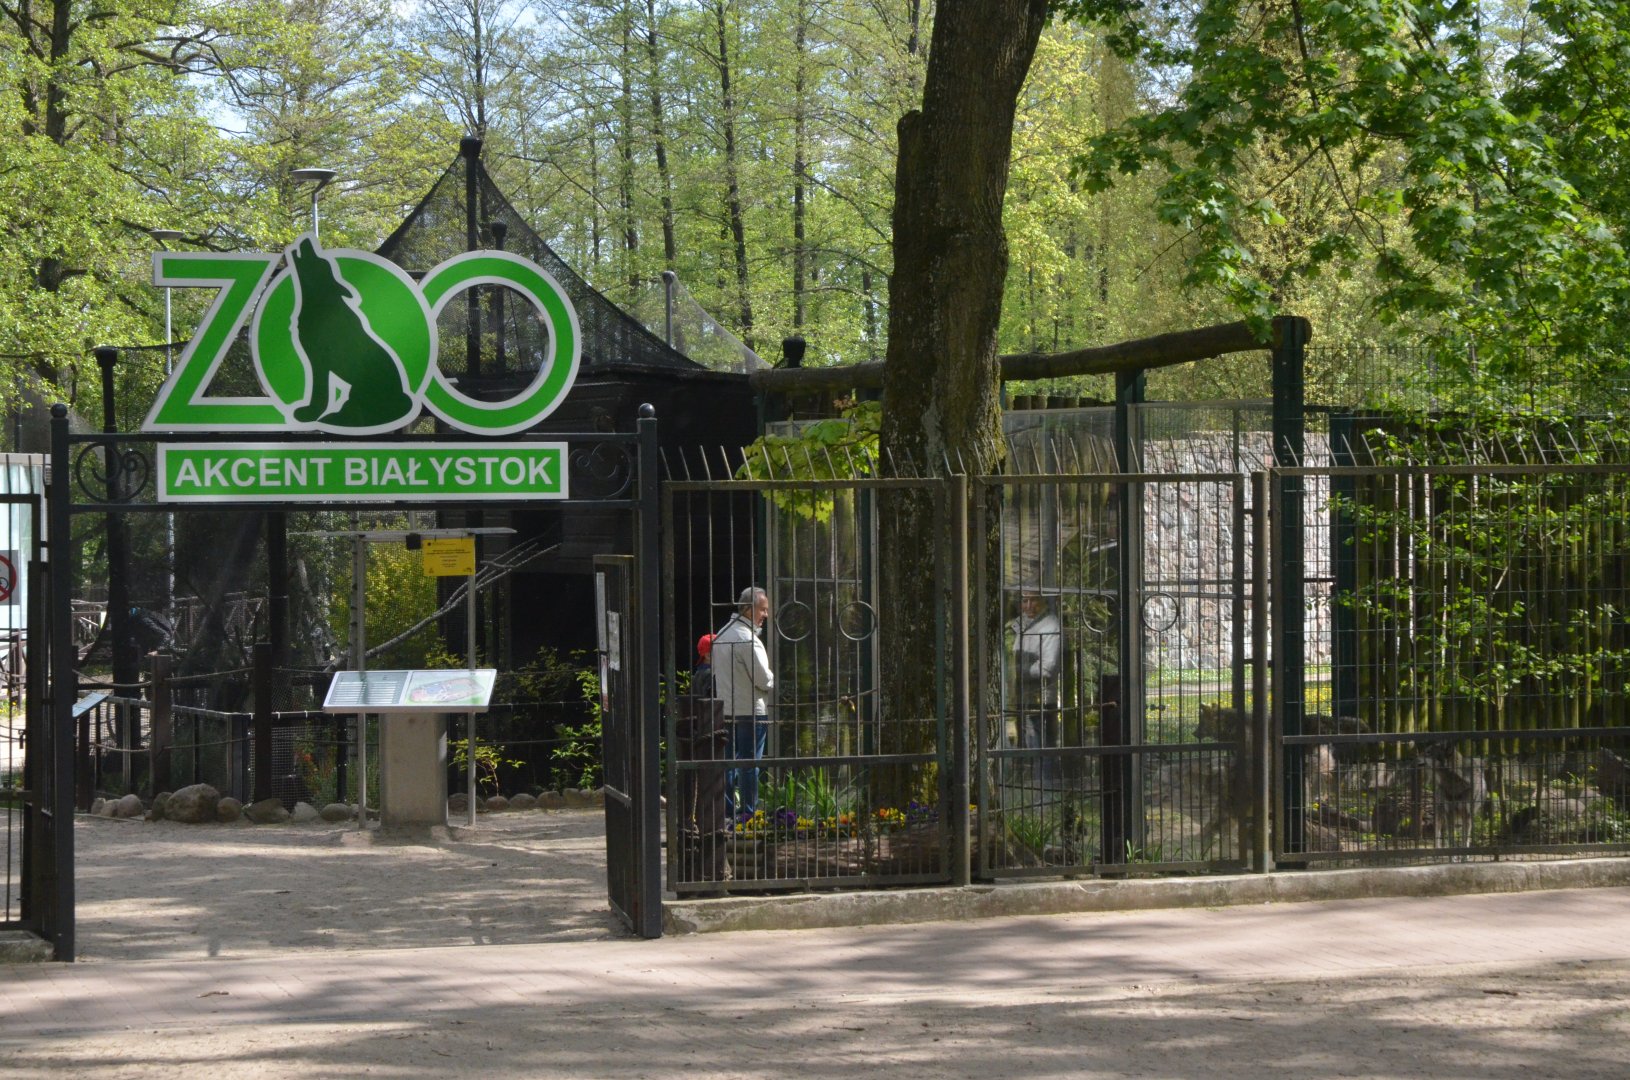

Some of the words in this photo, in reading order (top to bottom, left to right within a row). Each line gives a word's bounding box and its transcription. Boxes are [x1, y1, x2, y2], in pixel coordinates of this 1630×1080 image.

[141, 247, 582, 436] ZOO
[174, 457, 333, 487] AKCENT
[344, 456, 553, 486] BIAŁYSTOK
